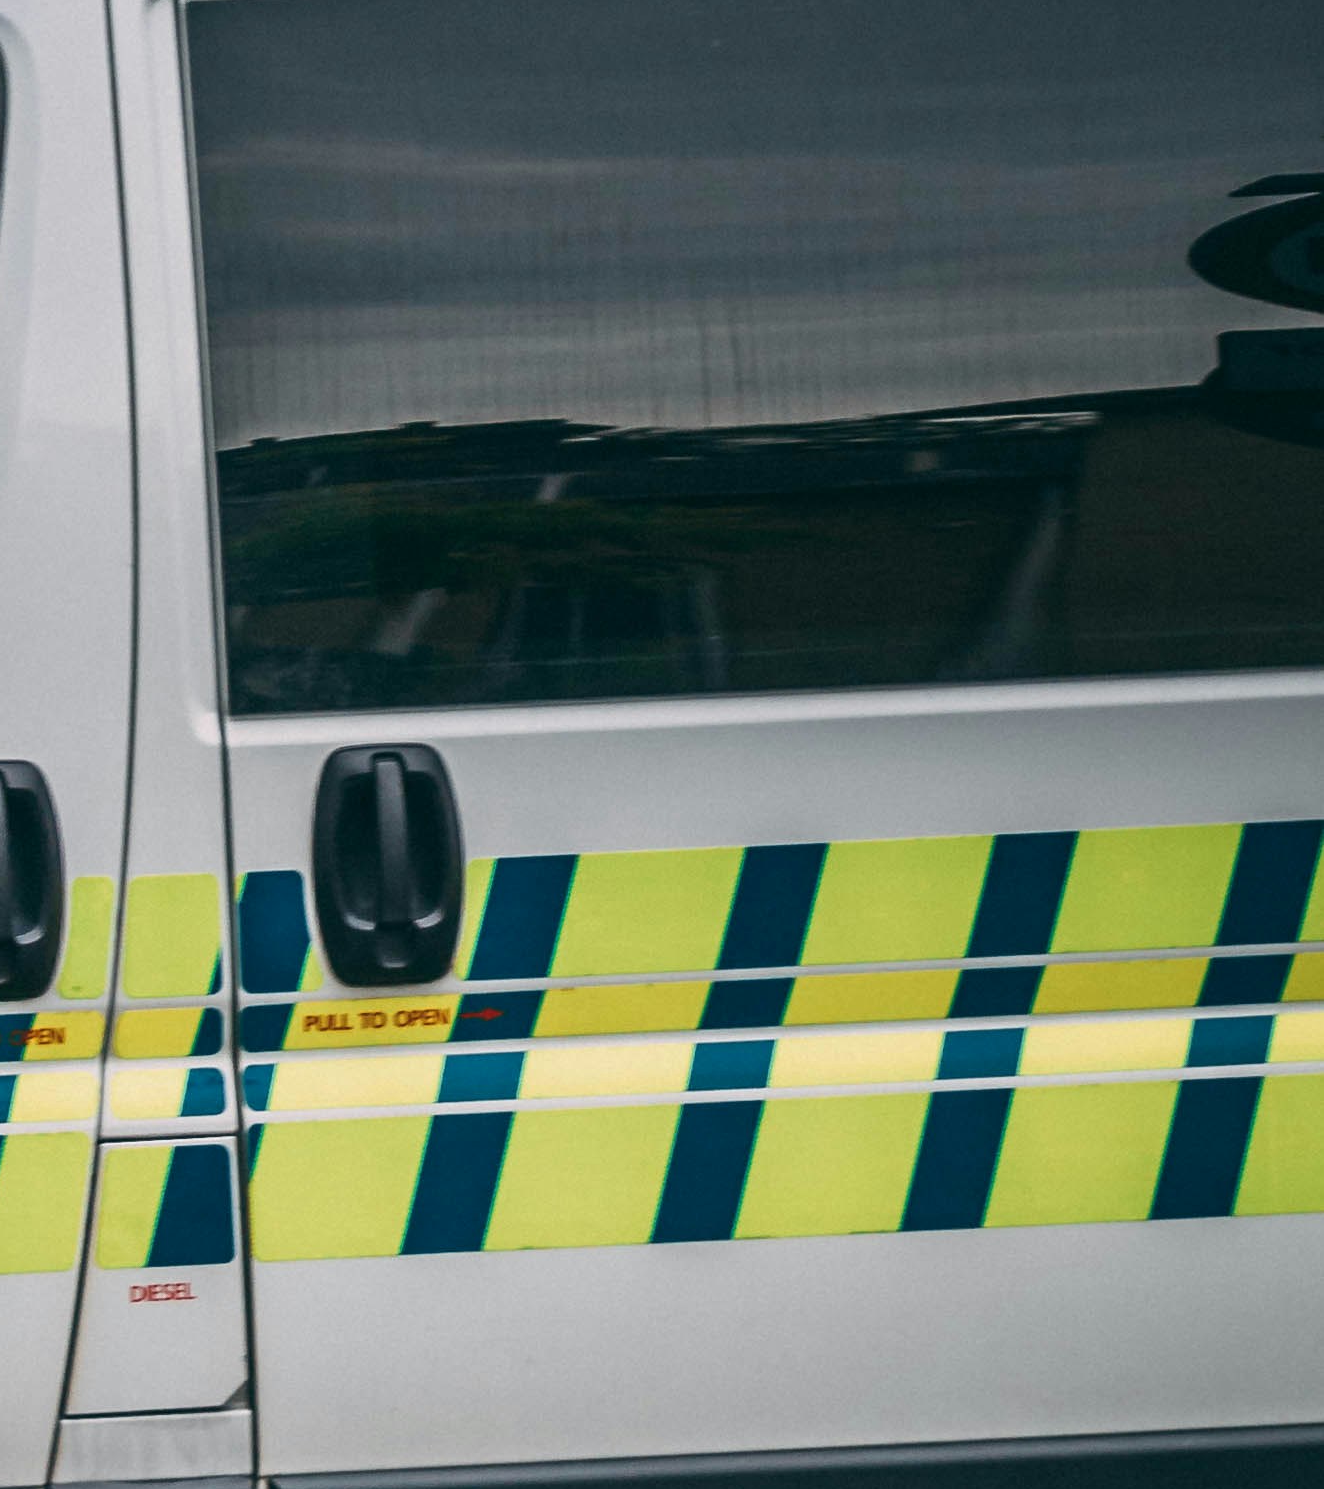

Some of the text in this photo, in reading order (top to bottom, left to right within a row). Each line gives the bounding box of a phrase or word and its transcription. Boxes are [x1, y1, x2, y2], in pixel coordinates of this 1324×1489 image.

[302, 1008, 450, 1032] PULL TO OPEN
[9, 1027, 66, 1046] OPEN
[129, 1282, 198, 1302] DIESEL
